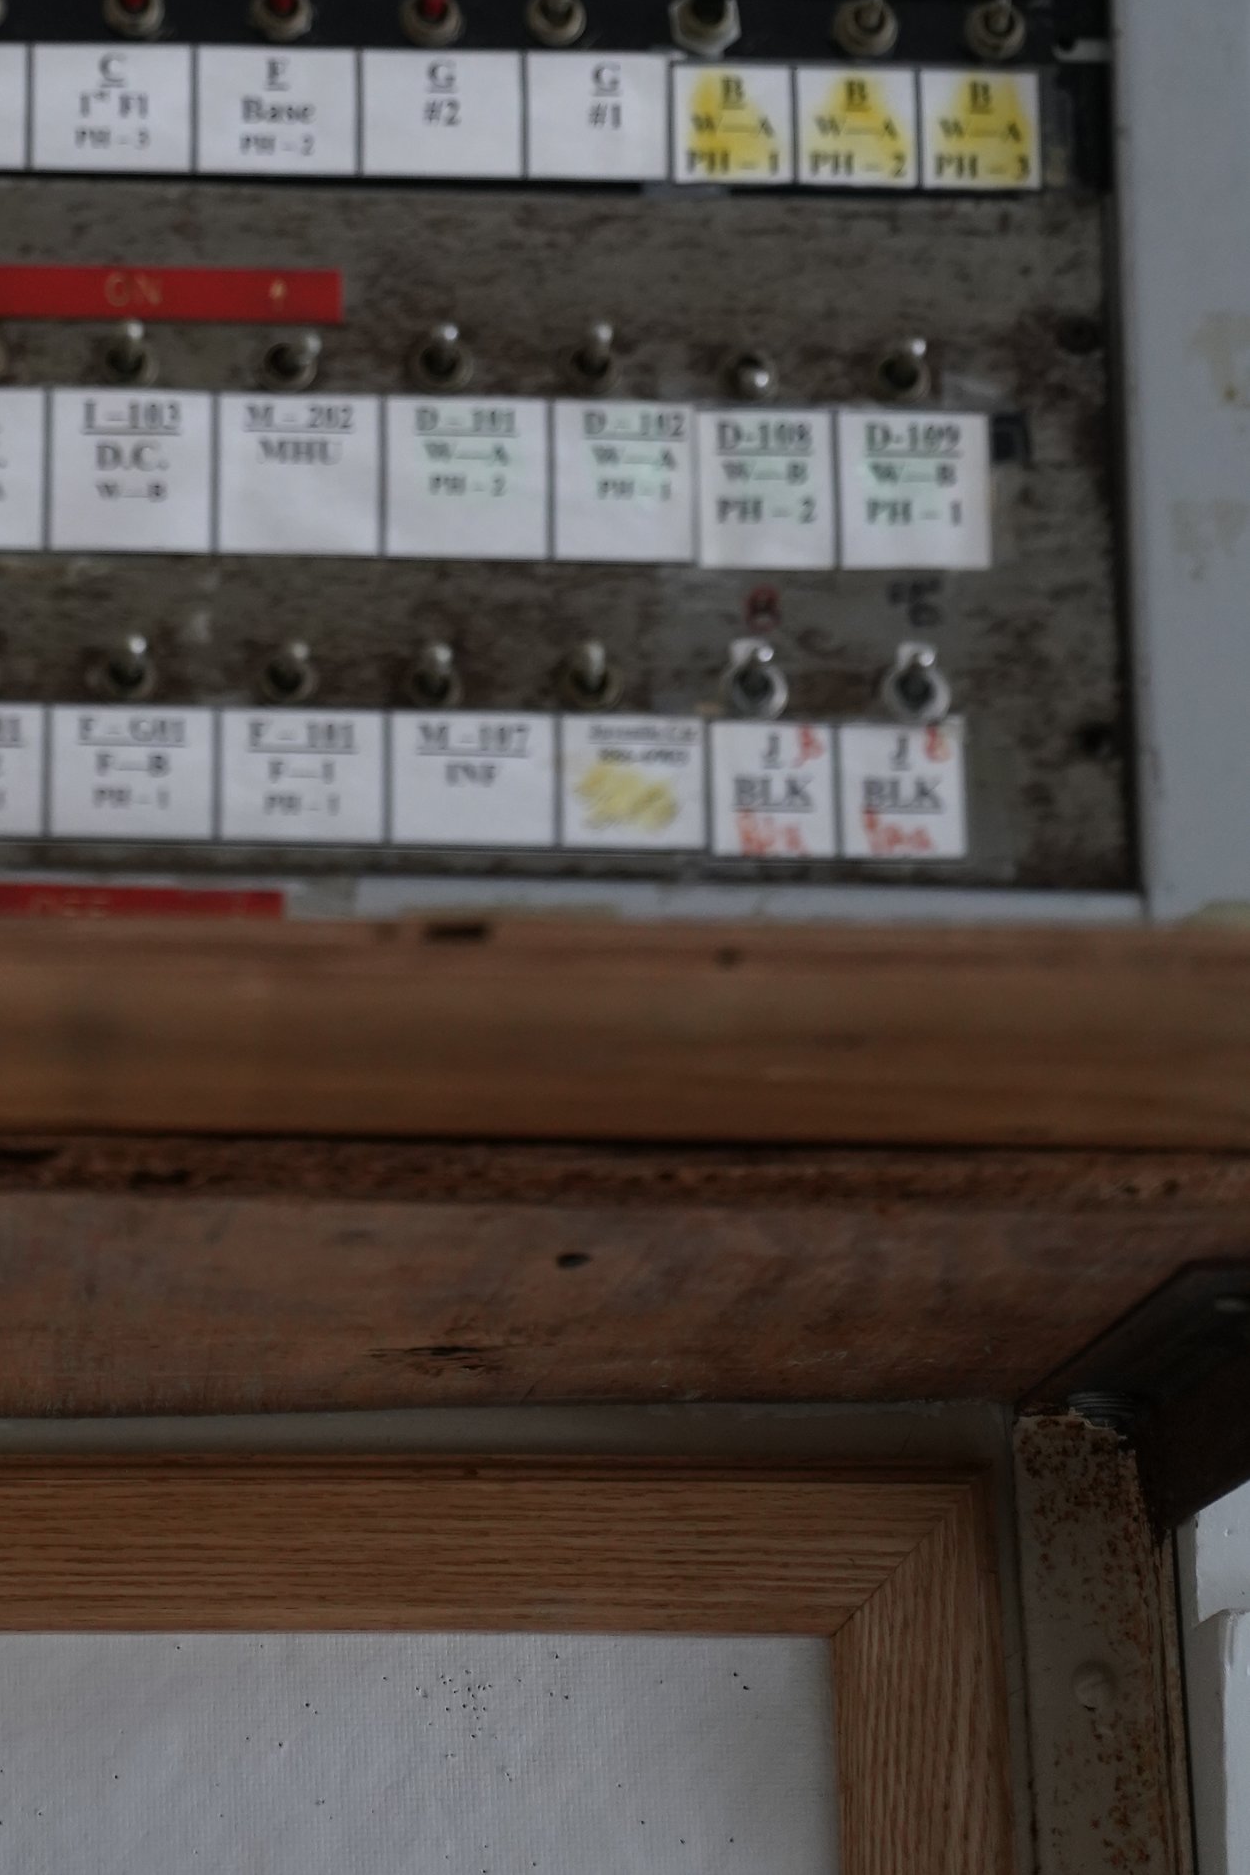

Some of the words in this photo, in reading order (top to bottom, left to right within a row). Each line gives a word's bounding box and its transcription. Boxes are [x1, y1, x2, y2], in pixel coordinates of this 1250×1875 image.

[100, 55, 125, 87] C
[426, 64, 455, 94] G
[591, 66, 620, 96] G
[720, 77, 745, 108] B
[845, 80, 869, 111] B
[969, 83, 991, 113] B
[241, 99, 314, 125] Base
[423, 100, 460, 126] #2
[588, 103, 623, 128] #1
[686, 150, 738, 175] PH
[810, 153, 862, 177] PH
[935, 155, 988, 179] PH
[105, 275, 162, 306] ON
[259, 440, 341, 466] MHU
[718, 500, 761, 524] PH
[867, 502, 911, 525] PH
[733, 778, 814, 809] BLK
[863, 781, 943, 812] BLK
